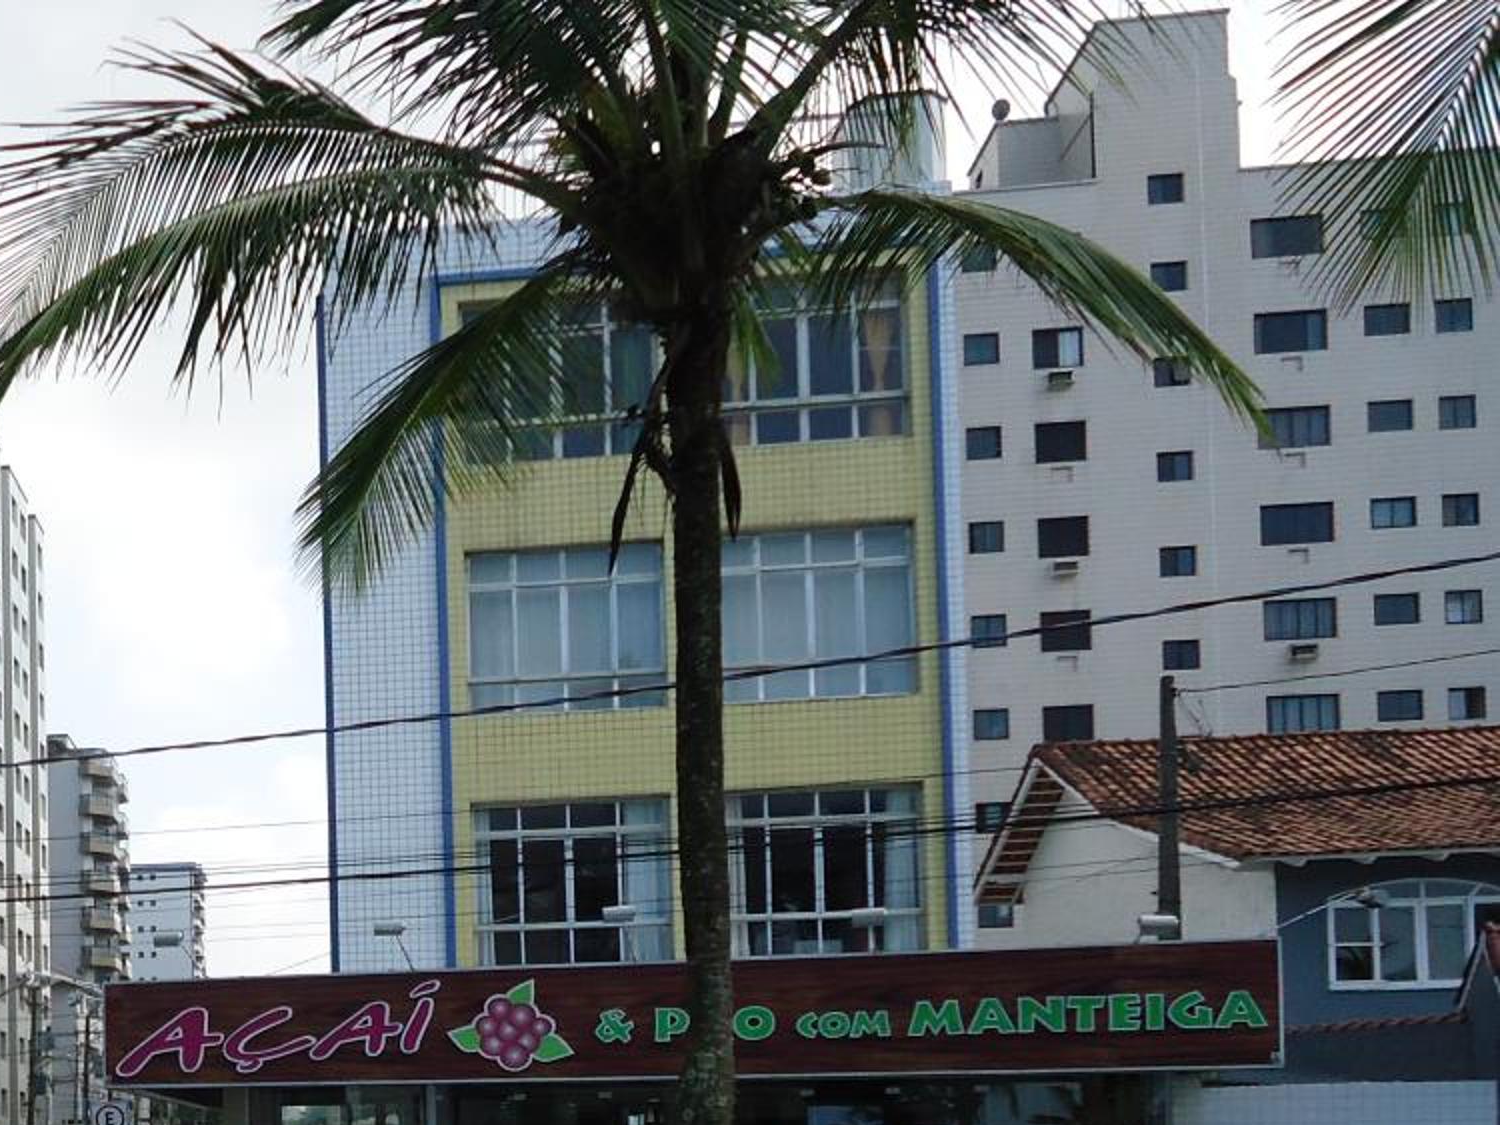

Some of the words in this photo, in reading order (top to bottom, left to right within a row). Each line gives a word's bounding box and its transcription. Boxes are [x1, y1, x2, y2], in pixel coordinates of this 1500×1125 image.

[115, 978, 441, 1077] AÇAÍ
[595, 1008, 635, 1043] &
[653, 1005, 776, 1042] PO
[795, 1010, 892, 1038] COM
[907, 989, 1268, 1037] MANTEIGA
